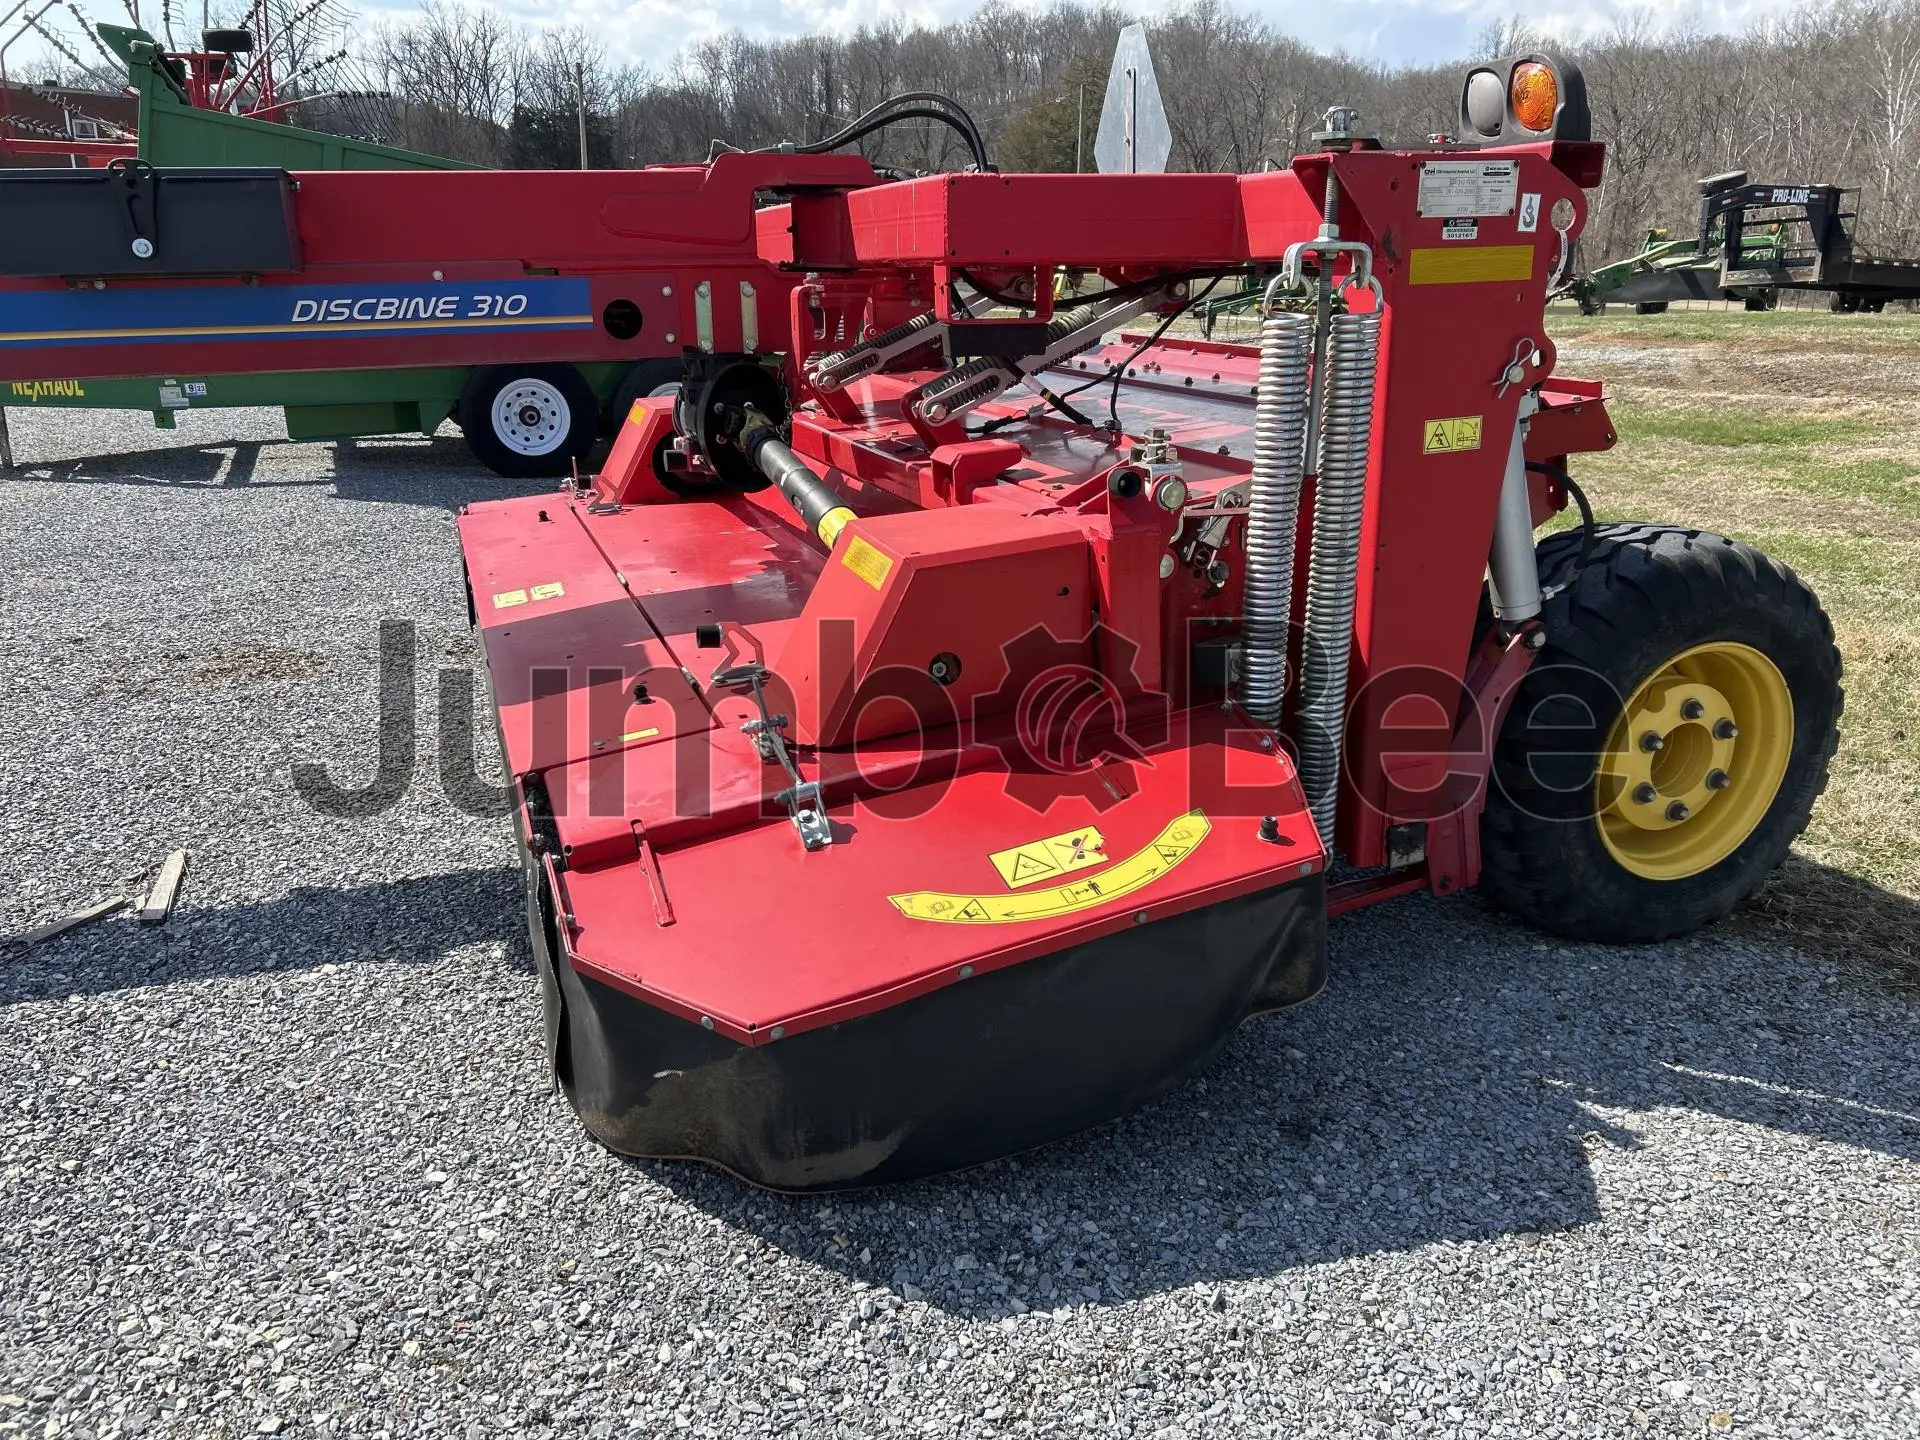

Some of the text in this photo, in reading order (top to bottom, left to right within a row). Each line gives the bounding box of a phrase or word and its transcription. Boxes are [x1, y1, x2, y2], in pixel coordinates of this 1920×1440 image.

[1771, 189, 1810, 203] PRO-LINE
[292, 294, 528, 321] DISCBINE 310
